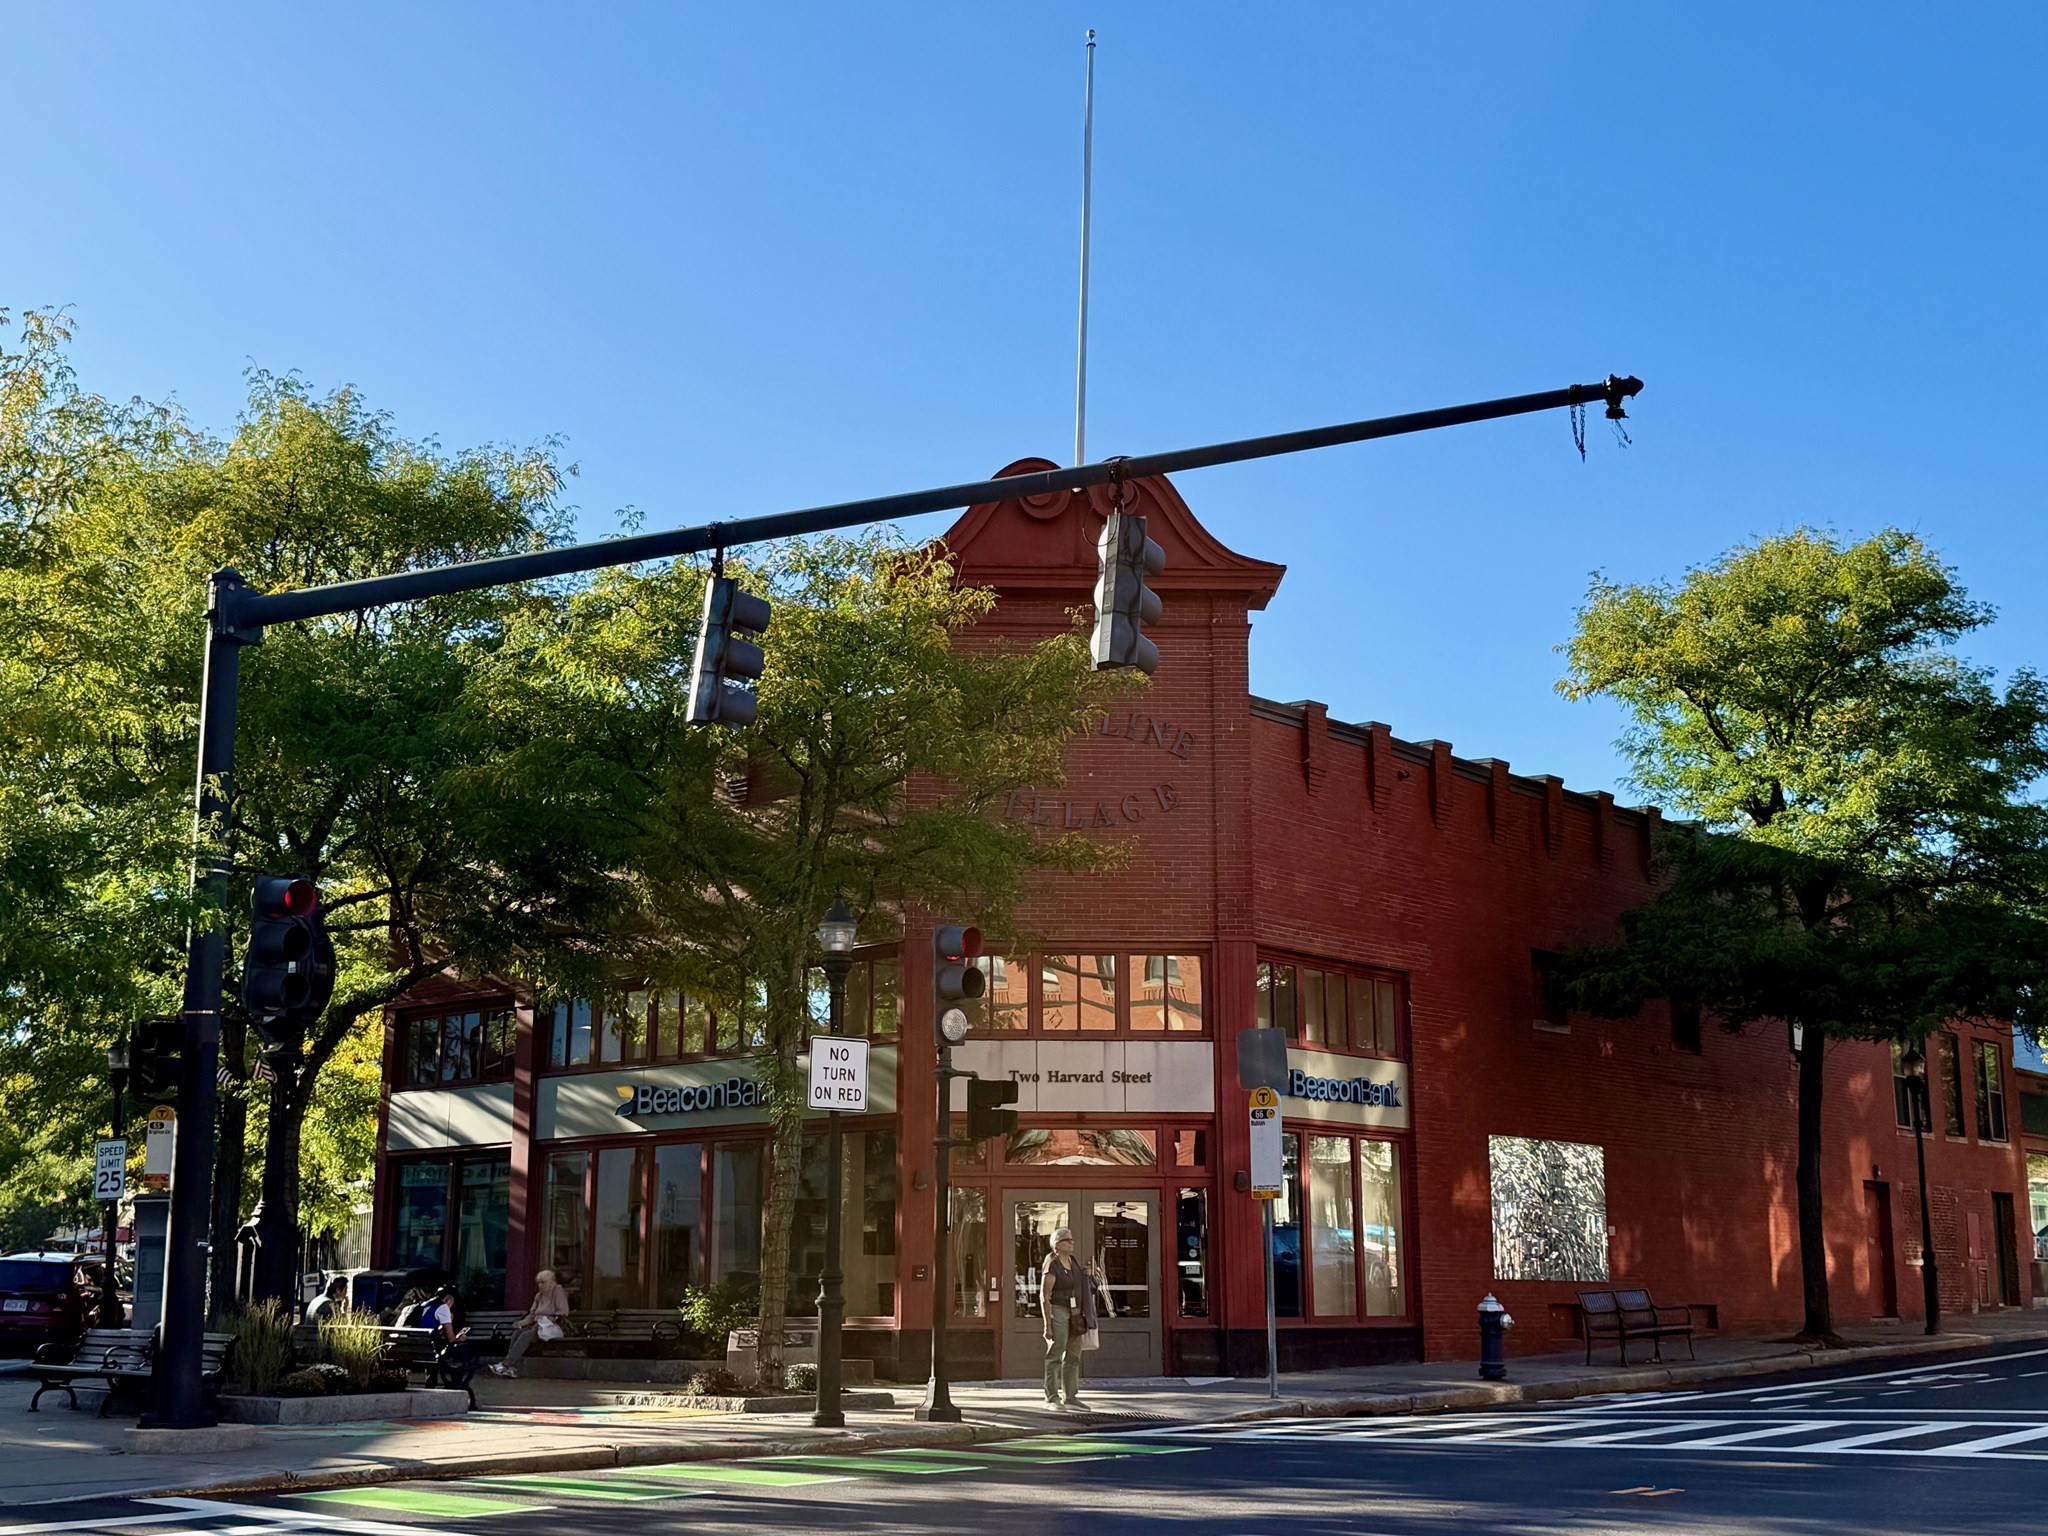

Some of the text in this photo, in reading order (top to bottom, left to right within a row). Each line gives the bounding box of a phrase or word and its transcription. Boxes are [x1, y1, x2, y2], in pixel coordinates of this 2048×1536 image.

[1004, 782, 1181, 828] ILLAGE
[829, 1047, 849, 1061] NO
[823, 1066, 856, 1081] TURN
[1009, 1070, 1152, 1083] Two Harvard Street
[636, 1076, 775, 1114] BeaconBan
[814, 1086, 862, 1102] ON RED
[1291, 1069, 1401, 1107] BeaconBank
[1254, 1109, 1264, 1119] 66
[99, 1146, 124, 1157] SPEED
[1077, 1145, 1085, 1155] 2
[101, 1158, 121, 1169] LIMIT
[98, 1171, 121, 1193] 25
